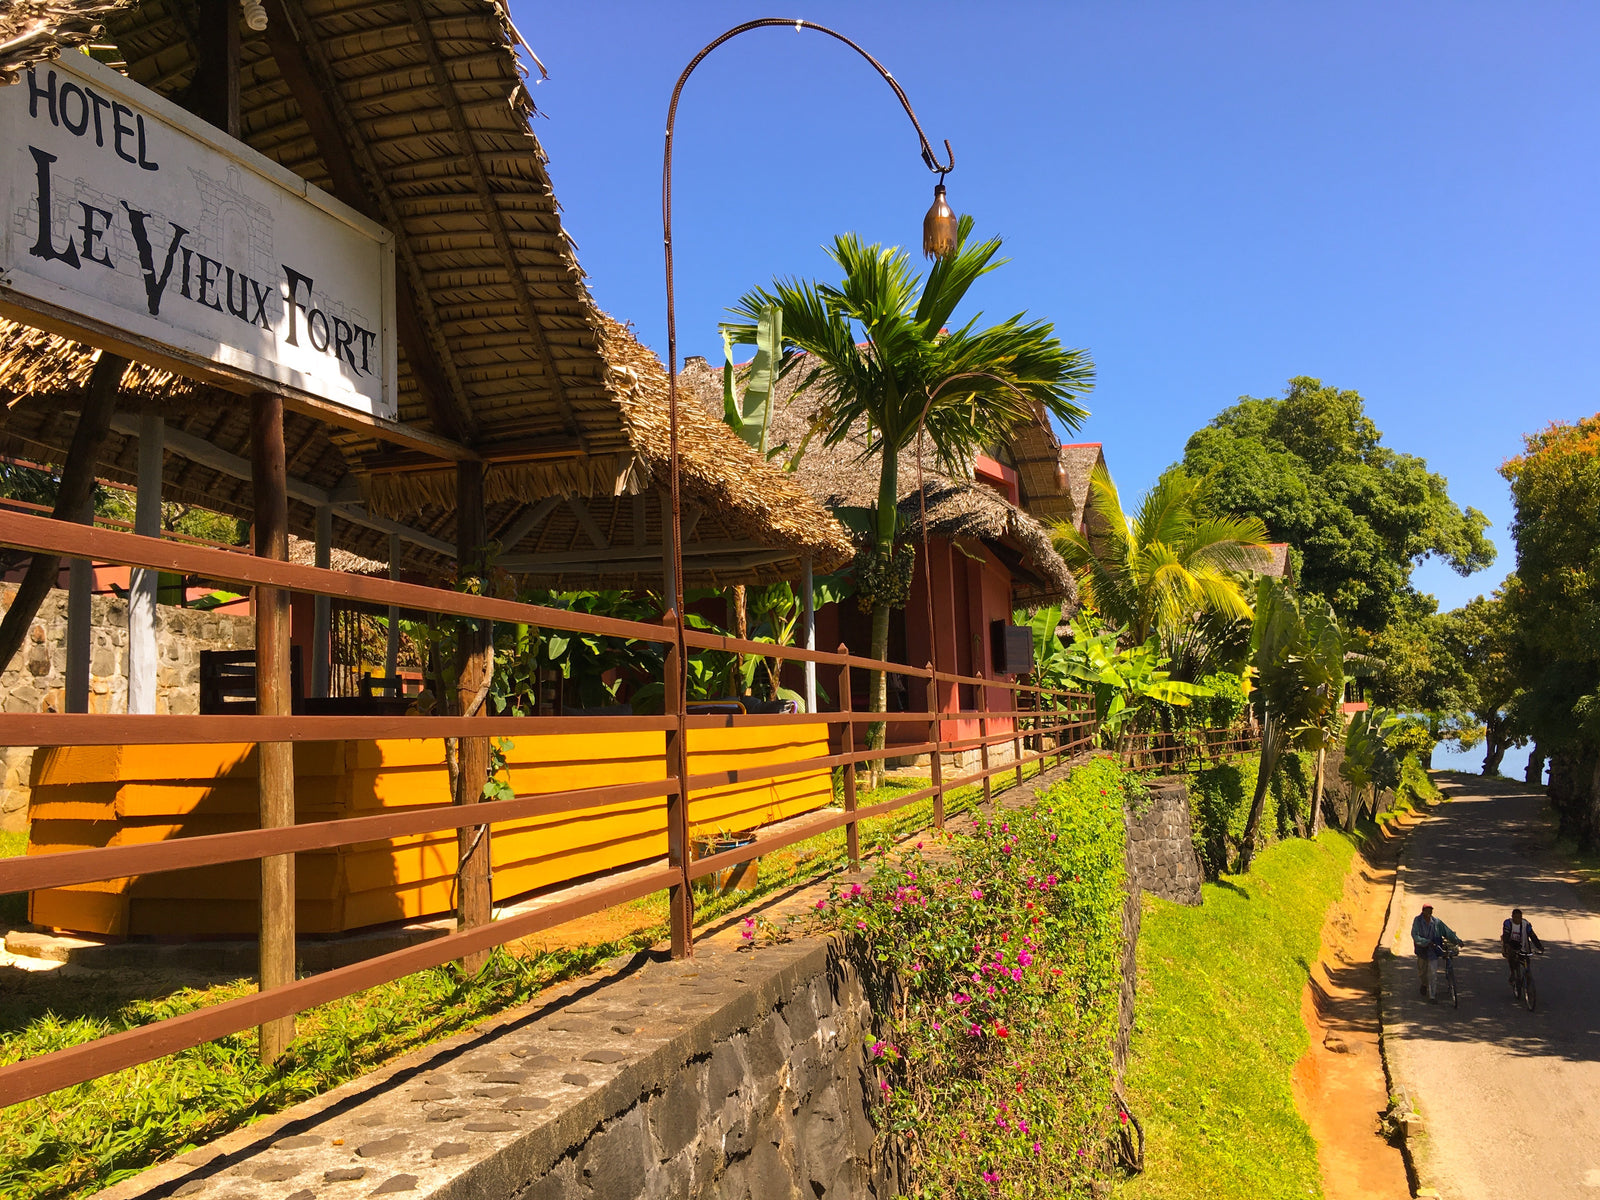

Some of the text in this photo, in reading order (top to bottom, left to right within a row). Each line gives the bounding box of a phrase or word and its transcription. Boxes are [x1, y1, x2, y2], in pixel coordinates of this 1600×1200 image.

[27, 67, 159, 171] HOTEL
[28, 145, 376, 377] LE VIEUX FORT
